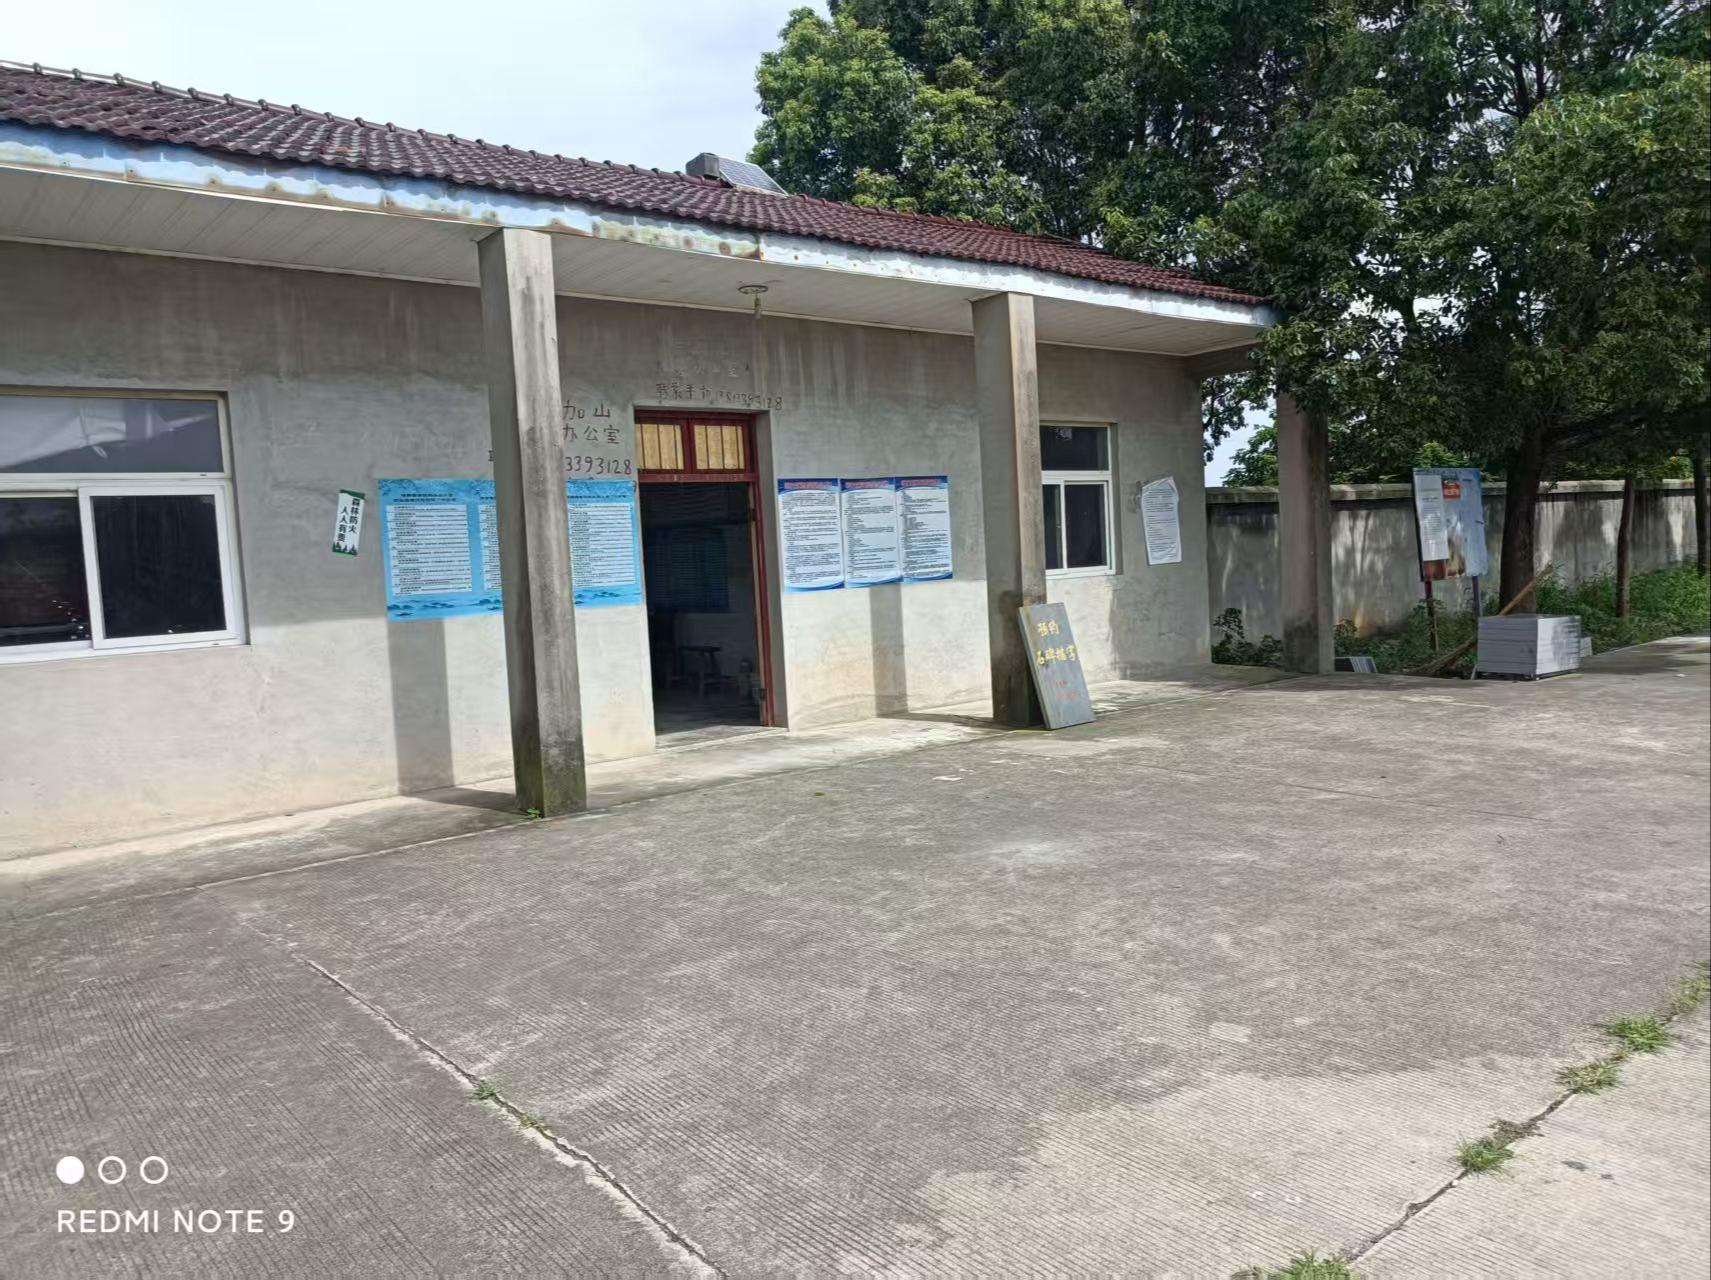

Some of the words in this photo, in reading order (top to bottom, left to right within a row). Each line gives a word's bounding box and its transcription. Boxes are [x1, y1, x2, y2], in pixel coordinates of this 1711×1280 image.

[562, 424, 620, 445] 办公室
[565, 455, 632, 475] 3393128
[337, 506, 349, 542] 人人有责
[348, 497, 361, 534] 森林防火
